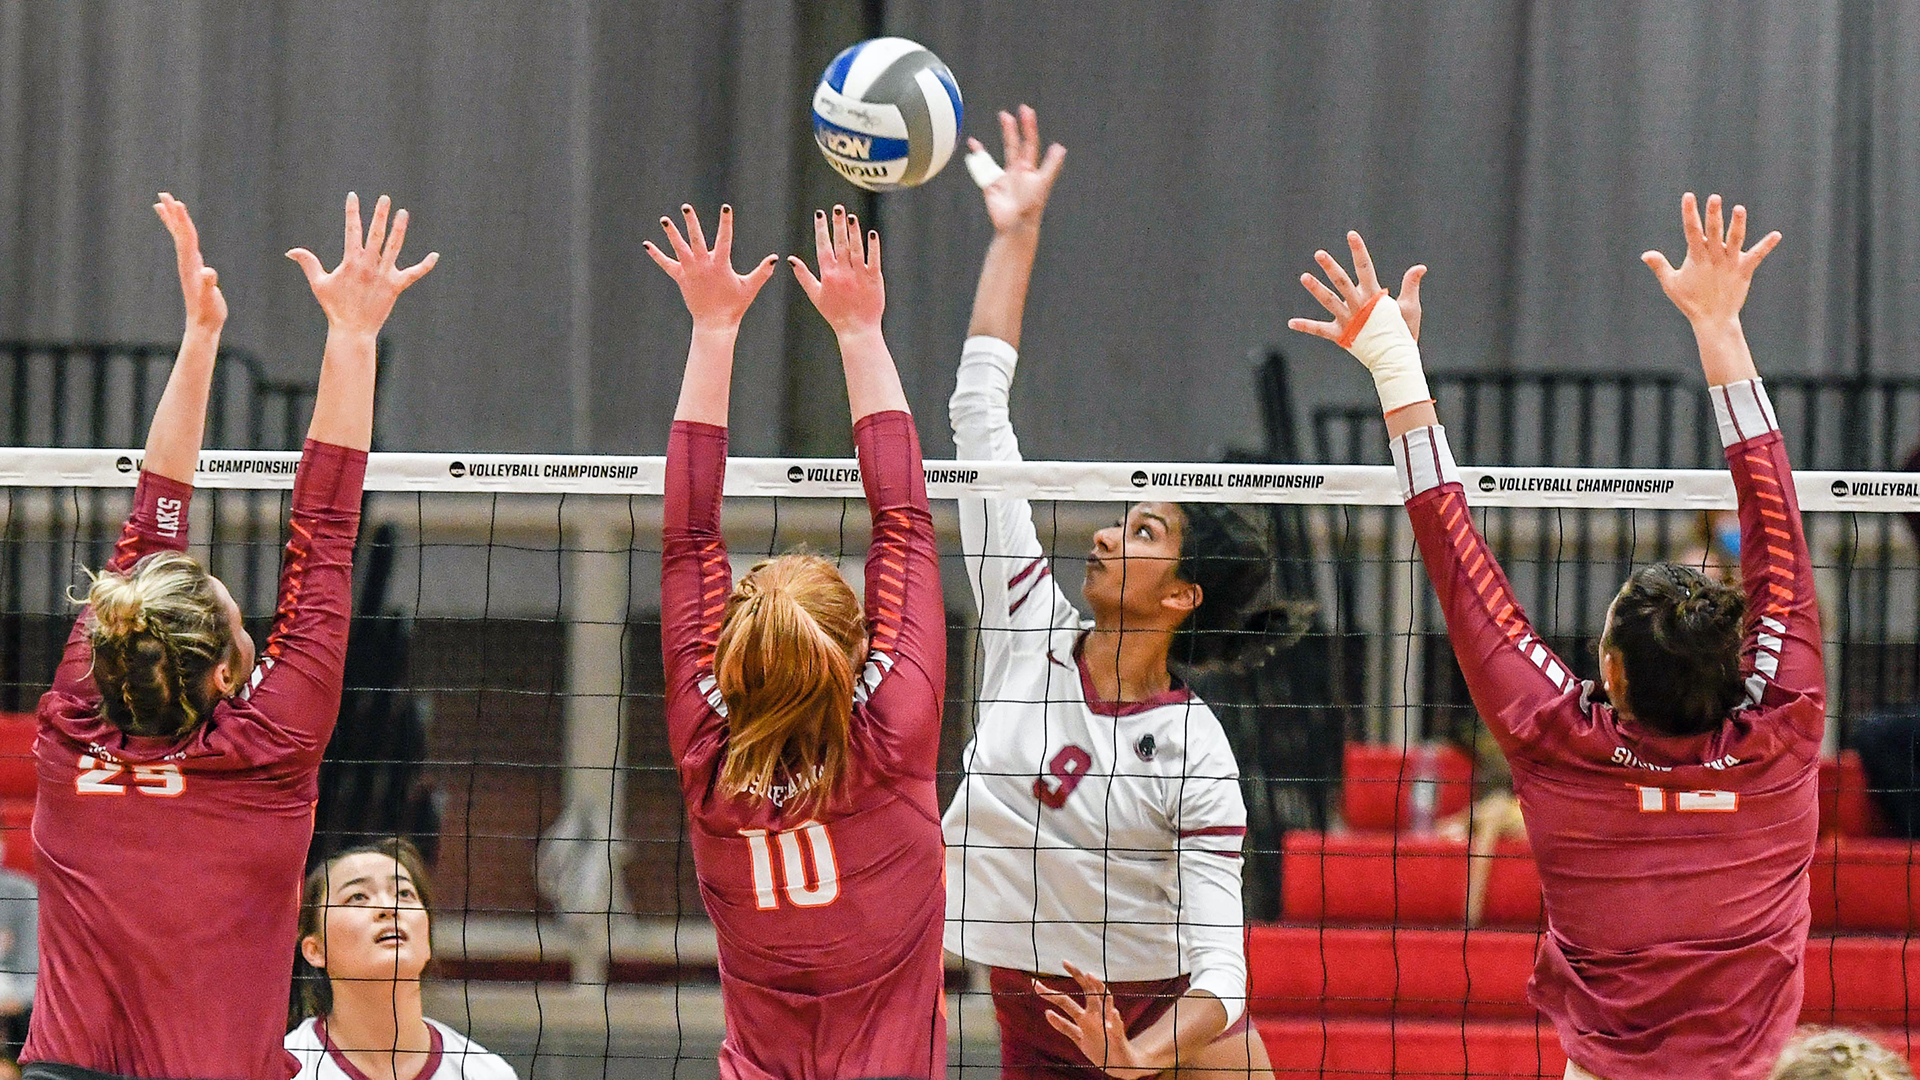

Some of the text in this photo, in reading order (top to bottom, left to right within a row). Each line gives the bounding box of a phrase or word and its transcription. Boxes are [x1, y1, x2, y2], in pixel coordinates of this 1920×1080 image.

[468, 463, 540, 478] VOLLEYBALL
[543, 464, 639, 479] CHAMPIONSHIP
[807, 468, 861, 482] VOLLEYB
[1151, 472, 1224, 487] VOLLEYBALL
[1227, 474, 1325, 489] CHAMPIONSHIP
[1499, 477, 1573, 492] VOLLEYBALL
[1576, 478, 1675, 493] CHAMPIONSHIP
[1033, 745, 1092, 809] 9
[738, 818, 841, 911] 10
